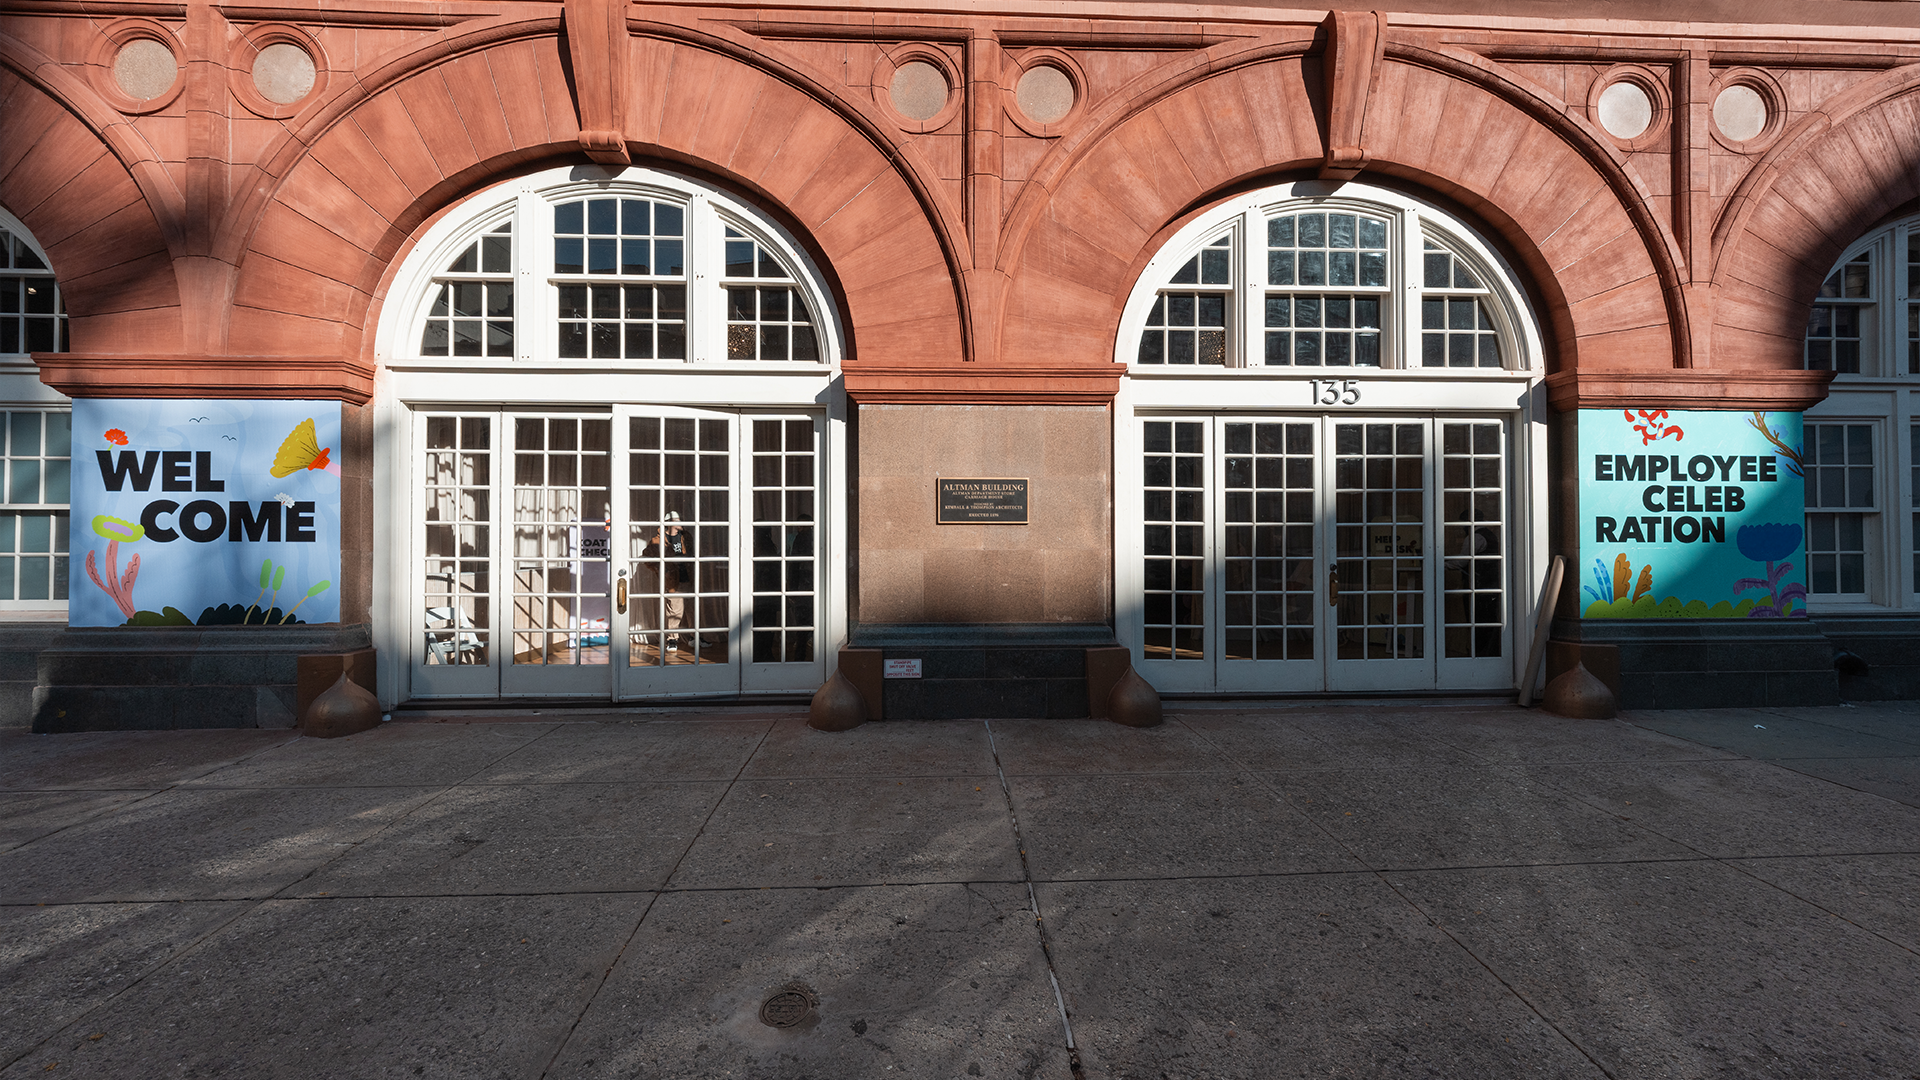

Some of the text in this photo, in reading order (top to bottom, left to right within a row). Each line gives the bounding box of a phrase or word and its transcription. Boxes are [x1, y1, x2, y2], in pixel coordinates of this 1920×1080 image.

[1309, 379, 1361, 405] 135
[95, 450, 225, 492] WEL
[1595, 454, 1777, 482] EMPLOYEE
[1642, 485, 1746, 512] CELEB
[140, 499, 316, 543] COME
[1595, 516, 1726, 543] RATION
[581, 539, 606, 547] OAT
[1385, 545, 1413, 553] DSK
